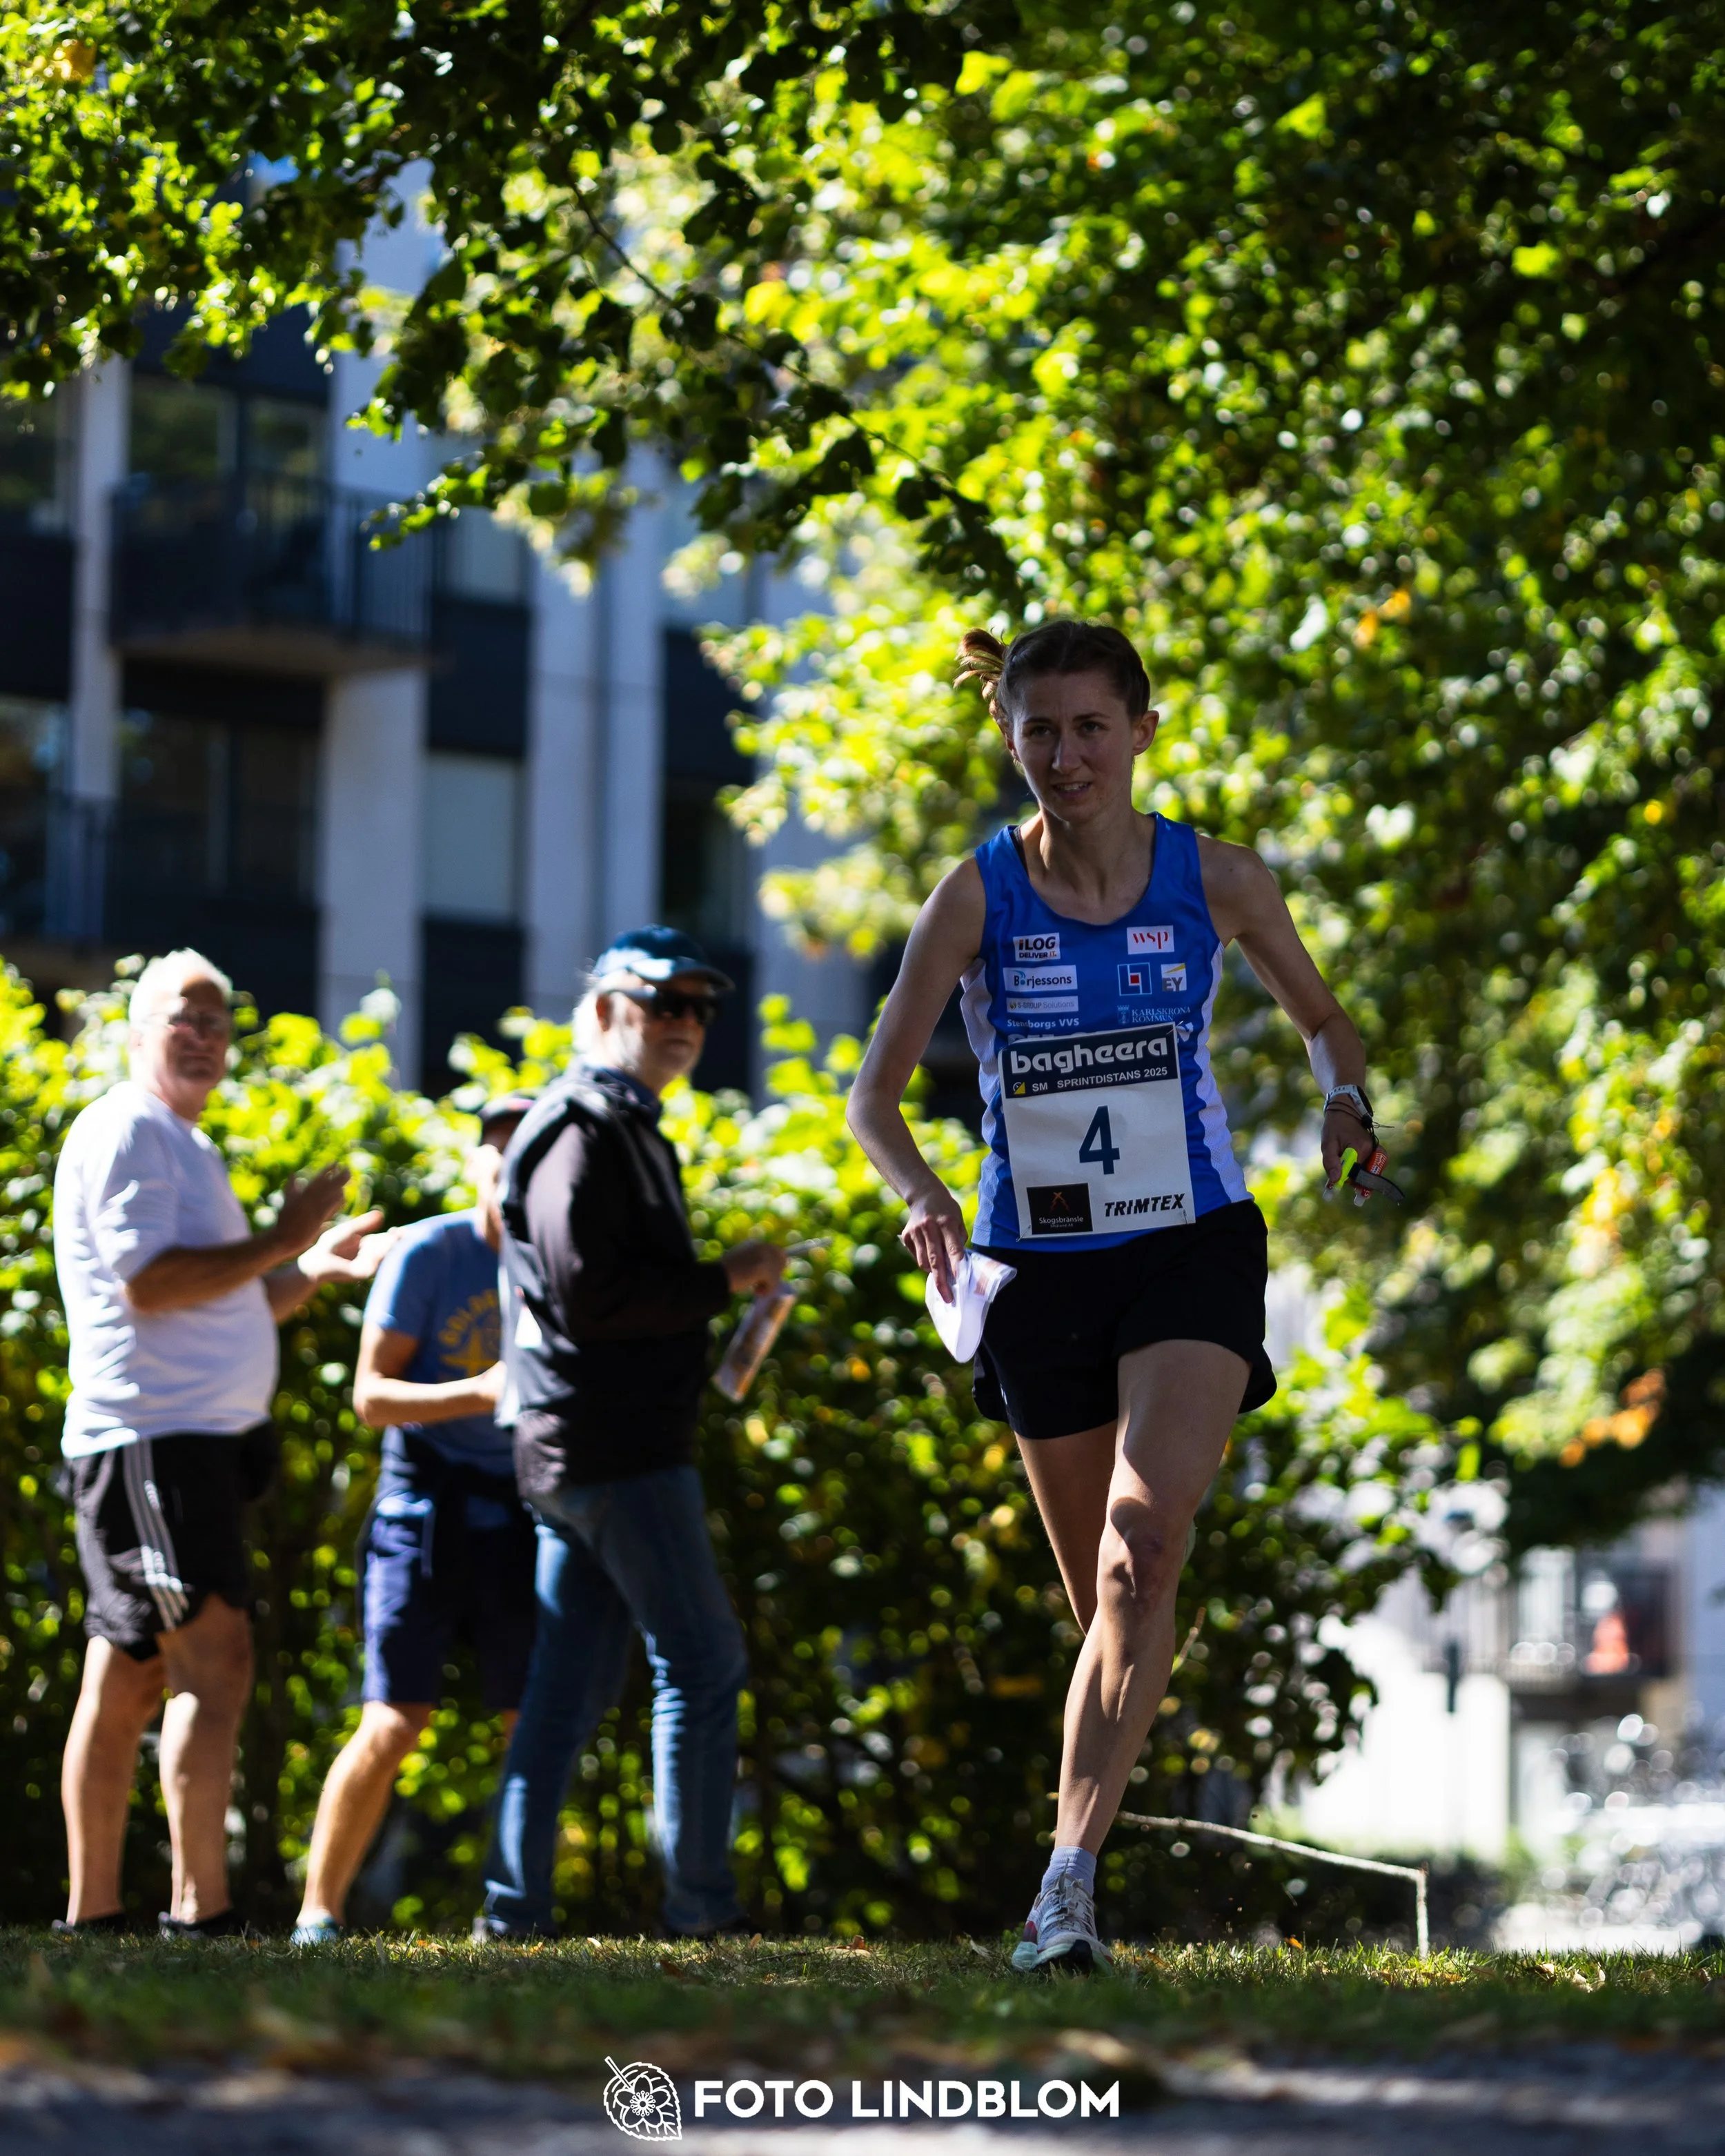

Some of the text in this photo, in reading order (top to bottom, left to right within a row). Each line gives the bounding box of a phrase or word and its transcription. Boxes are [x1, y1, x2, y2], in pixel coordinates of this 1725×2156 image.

[1163, 976, 1183, 991] EY
[1132, 1006, 1191, 1016] KARLSKRONA
[1132, 1015, 1173, 1023] KOMMUN
[1058, 1018, 1079, 1027] VVS
[1011, 1037, 1167, 1074] bagheera
[1032, 1067, 1168, 1092] SM SPRINTDISTANS 2025
[1078, 1105, 1121, 1175] 4
[1104, 1193, 1185, 1217] TRIMTEX
